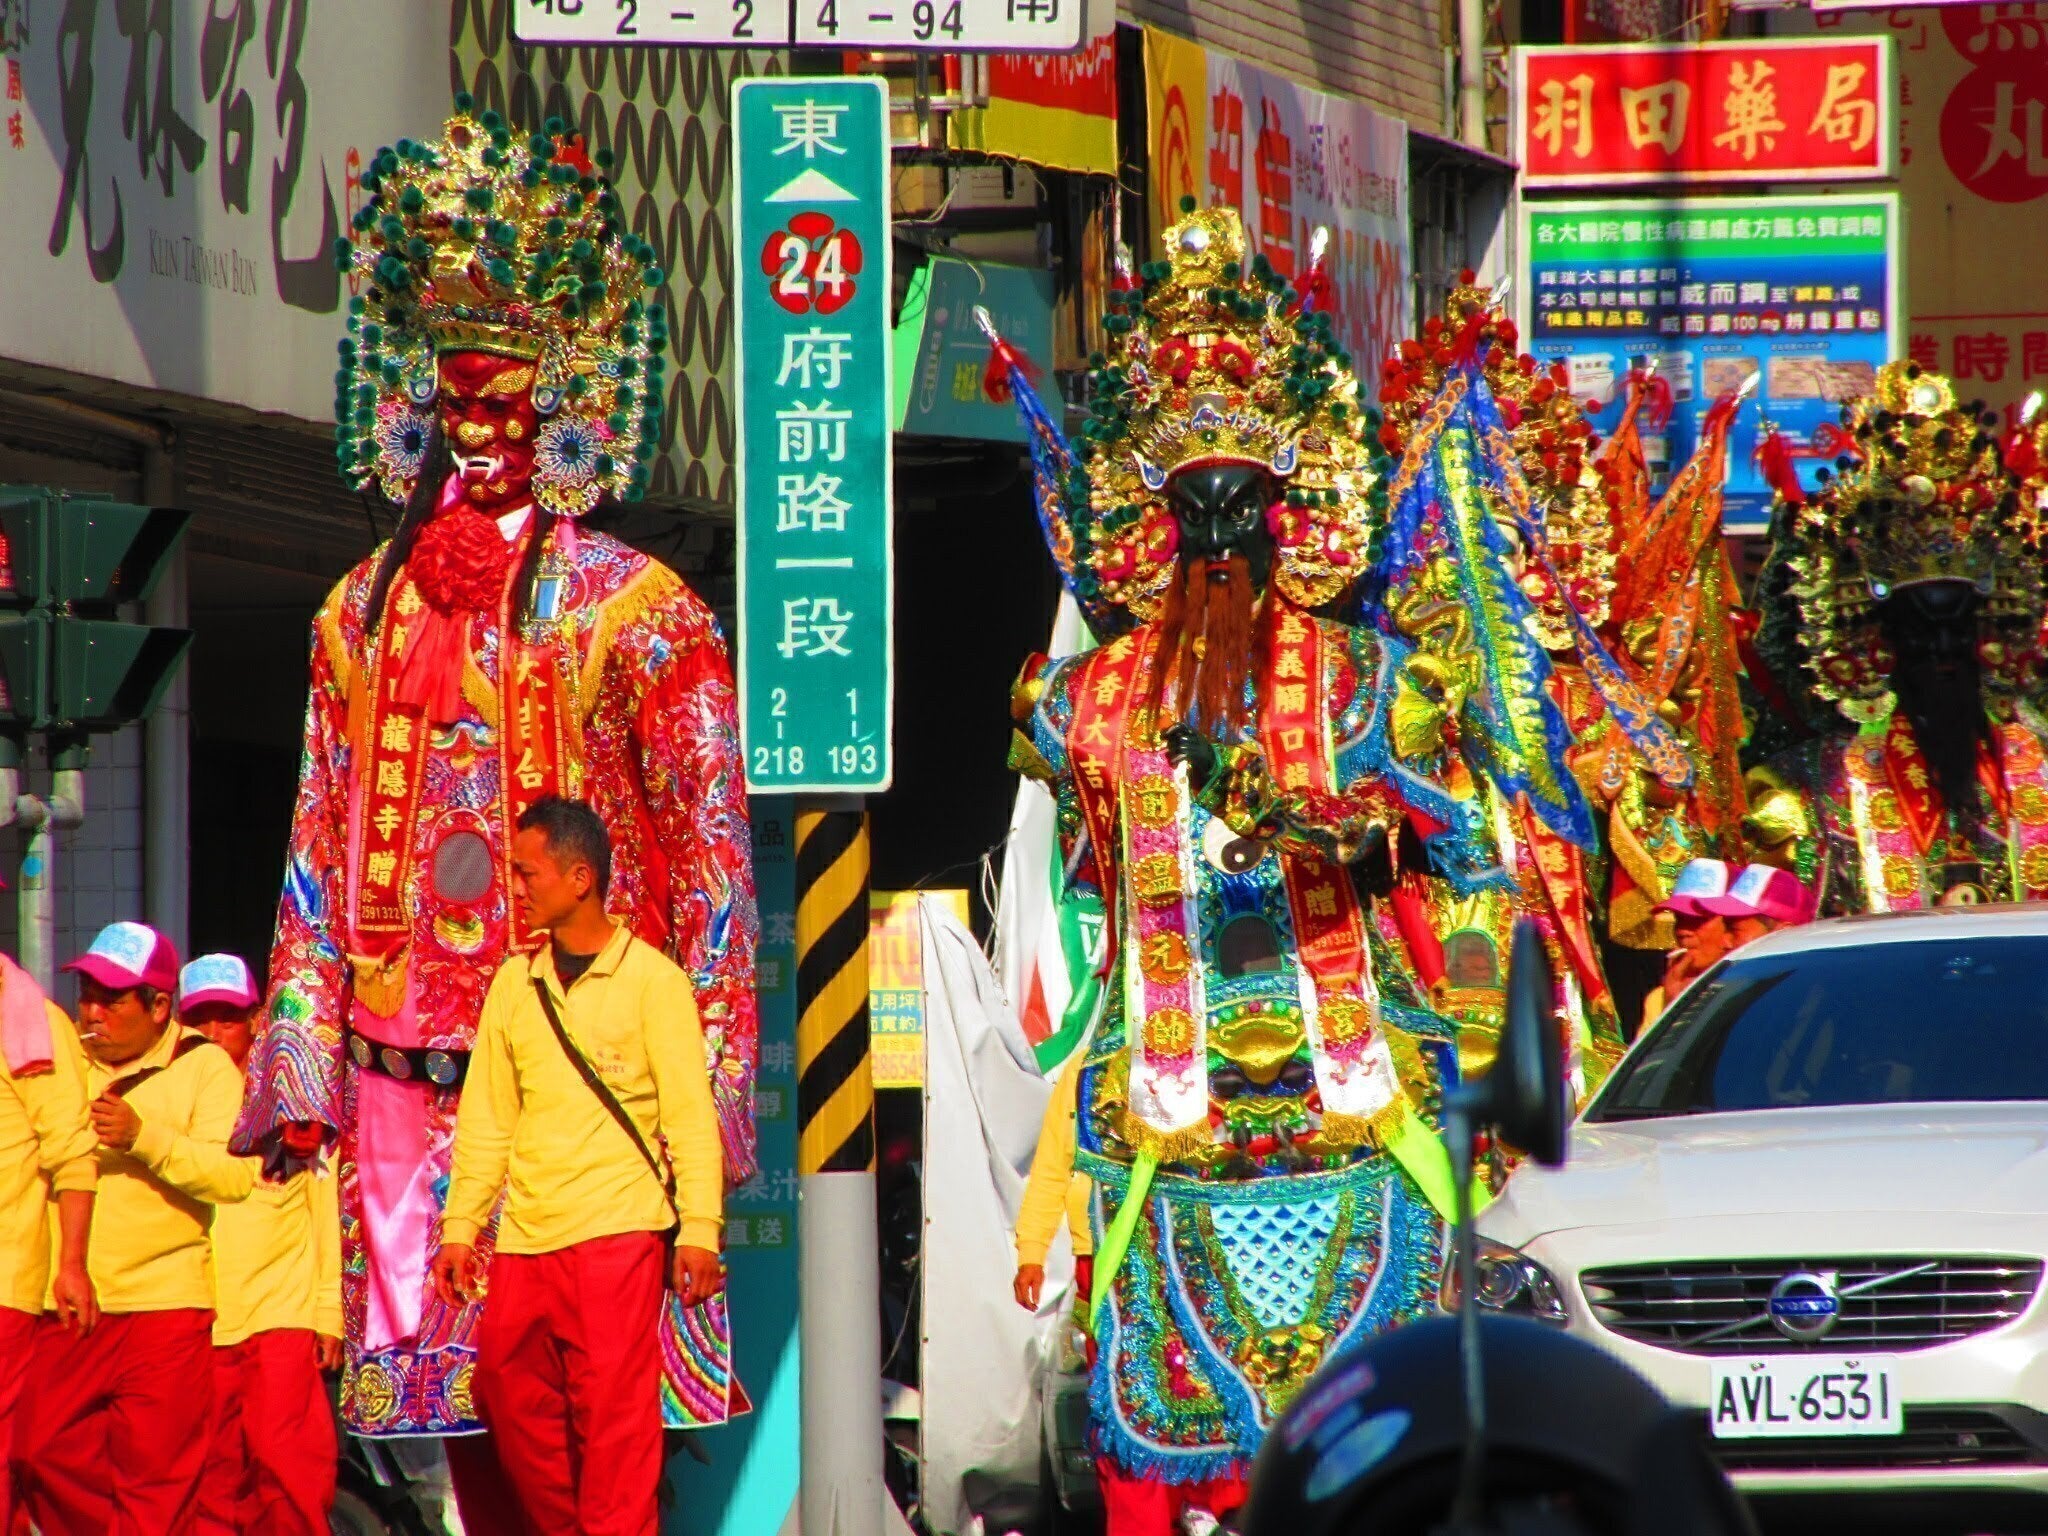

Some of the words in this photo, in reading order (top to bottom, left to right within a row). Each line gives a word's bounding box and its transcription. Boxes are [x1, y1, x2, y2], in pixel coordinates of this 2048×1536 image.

[913, 0, 963, 40] 94
[773, 98, 849, 158] 東
[1532, 59, 1877, 161] 羽田藥局
[231, 250, 257, 296] BUN
[779, 236, 844, 296] 24
[774, 327, 854, 658] 府前路一段
[771, 688, 787, 716] 2
[754, 745, 804, 775] 218
[828, 745, 877, 775] 193
[723, 1168, 797, 1202] 果汁
